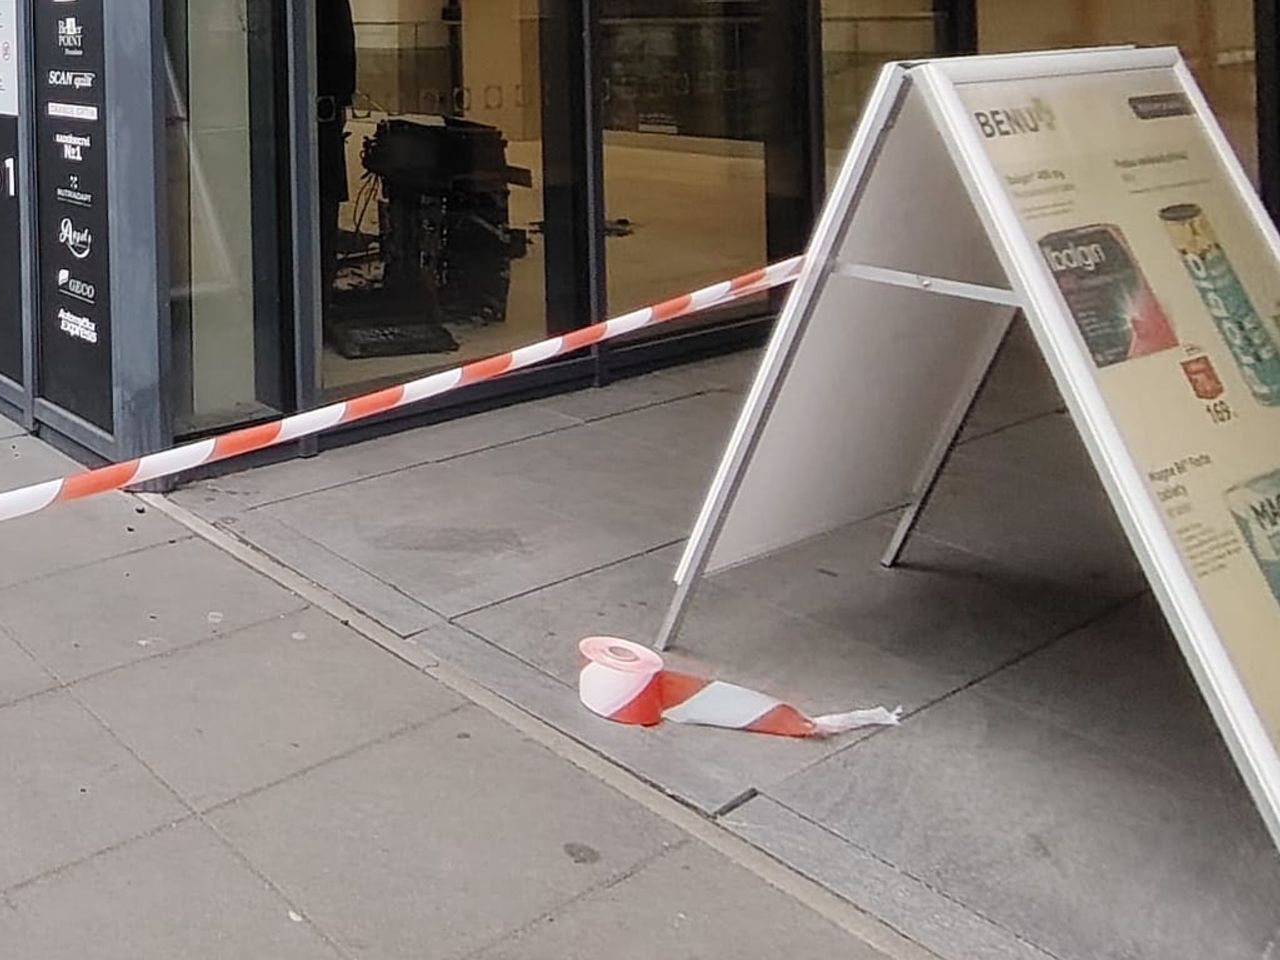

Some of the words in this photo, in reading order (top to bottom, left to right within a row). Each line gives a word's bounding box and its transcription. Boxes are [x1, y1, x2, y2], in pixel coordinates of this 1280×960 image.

[974, 104, 1038, 139] BENU
[4, 157, 16, 197] 1
[69, 278, 95, 299] GECO
